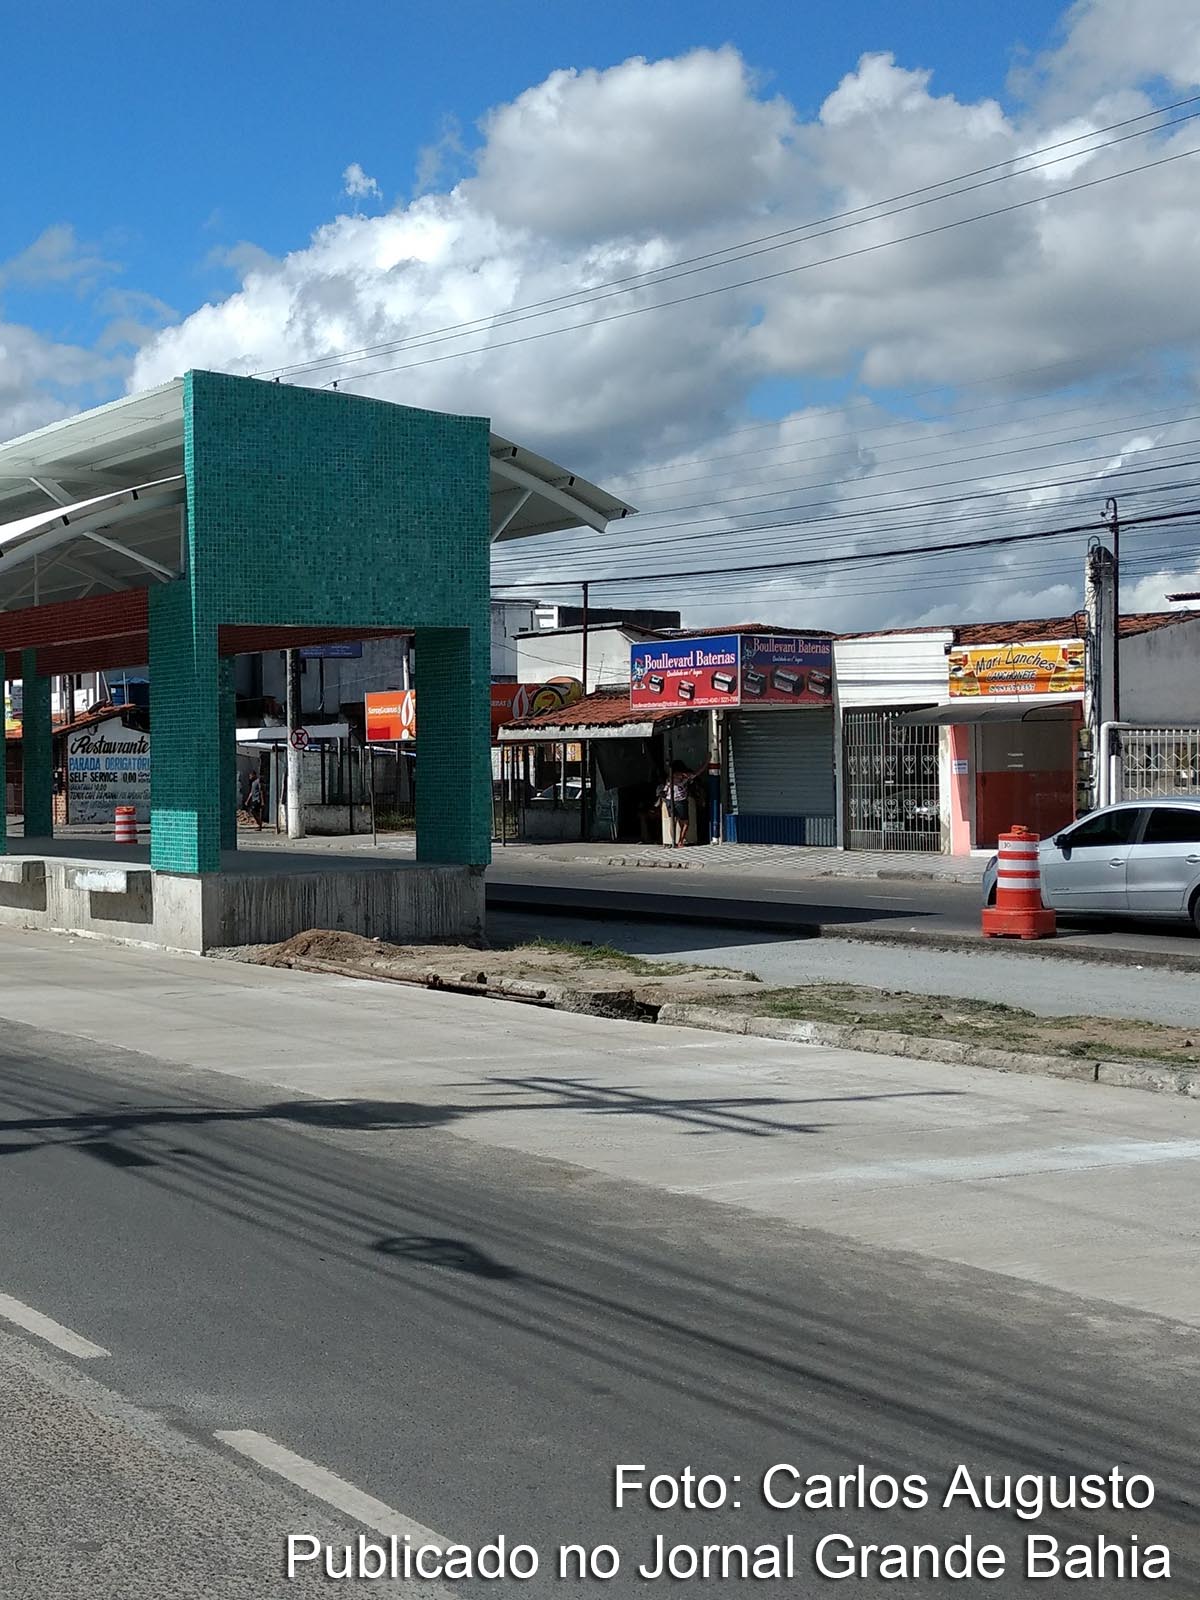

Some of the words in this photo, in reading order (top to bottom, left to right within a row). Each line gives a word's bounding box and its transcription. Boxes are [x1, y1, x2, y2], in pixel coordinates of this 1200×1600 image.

[753, 638, 796, 653] Boullevard
[798, 640, 831, 654] Baterias
[644, 651, 694, 670] Boullevard
[696, 649, 736, 666] Baterias
[975, 653, 1002, 676] Mari
[1005, 650, 1056, 671] Lanches
[986, 670, 1037, 682] LANCHONETE
[70, 735, 151, 755] Restaurante
[69, 757, 101, 771] PARADA
[70, 772, 87, 782] SELF
[90, 772, 118, 782] SERVICE
